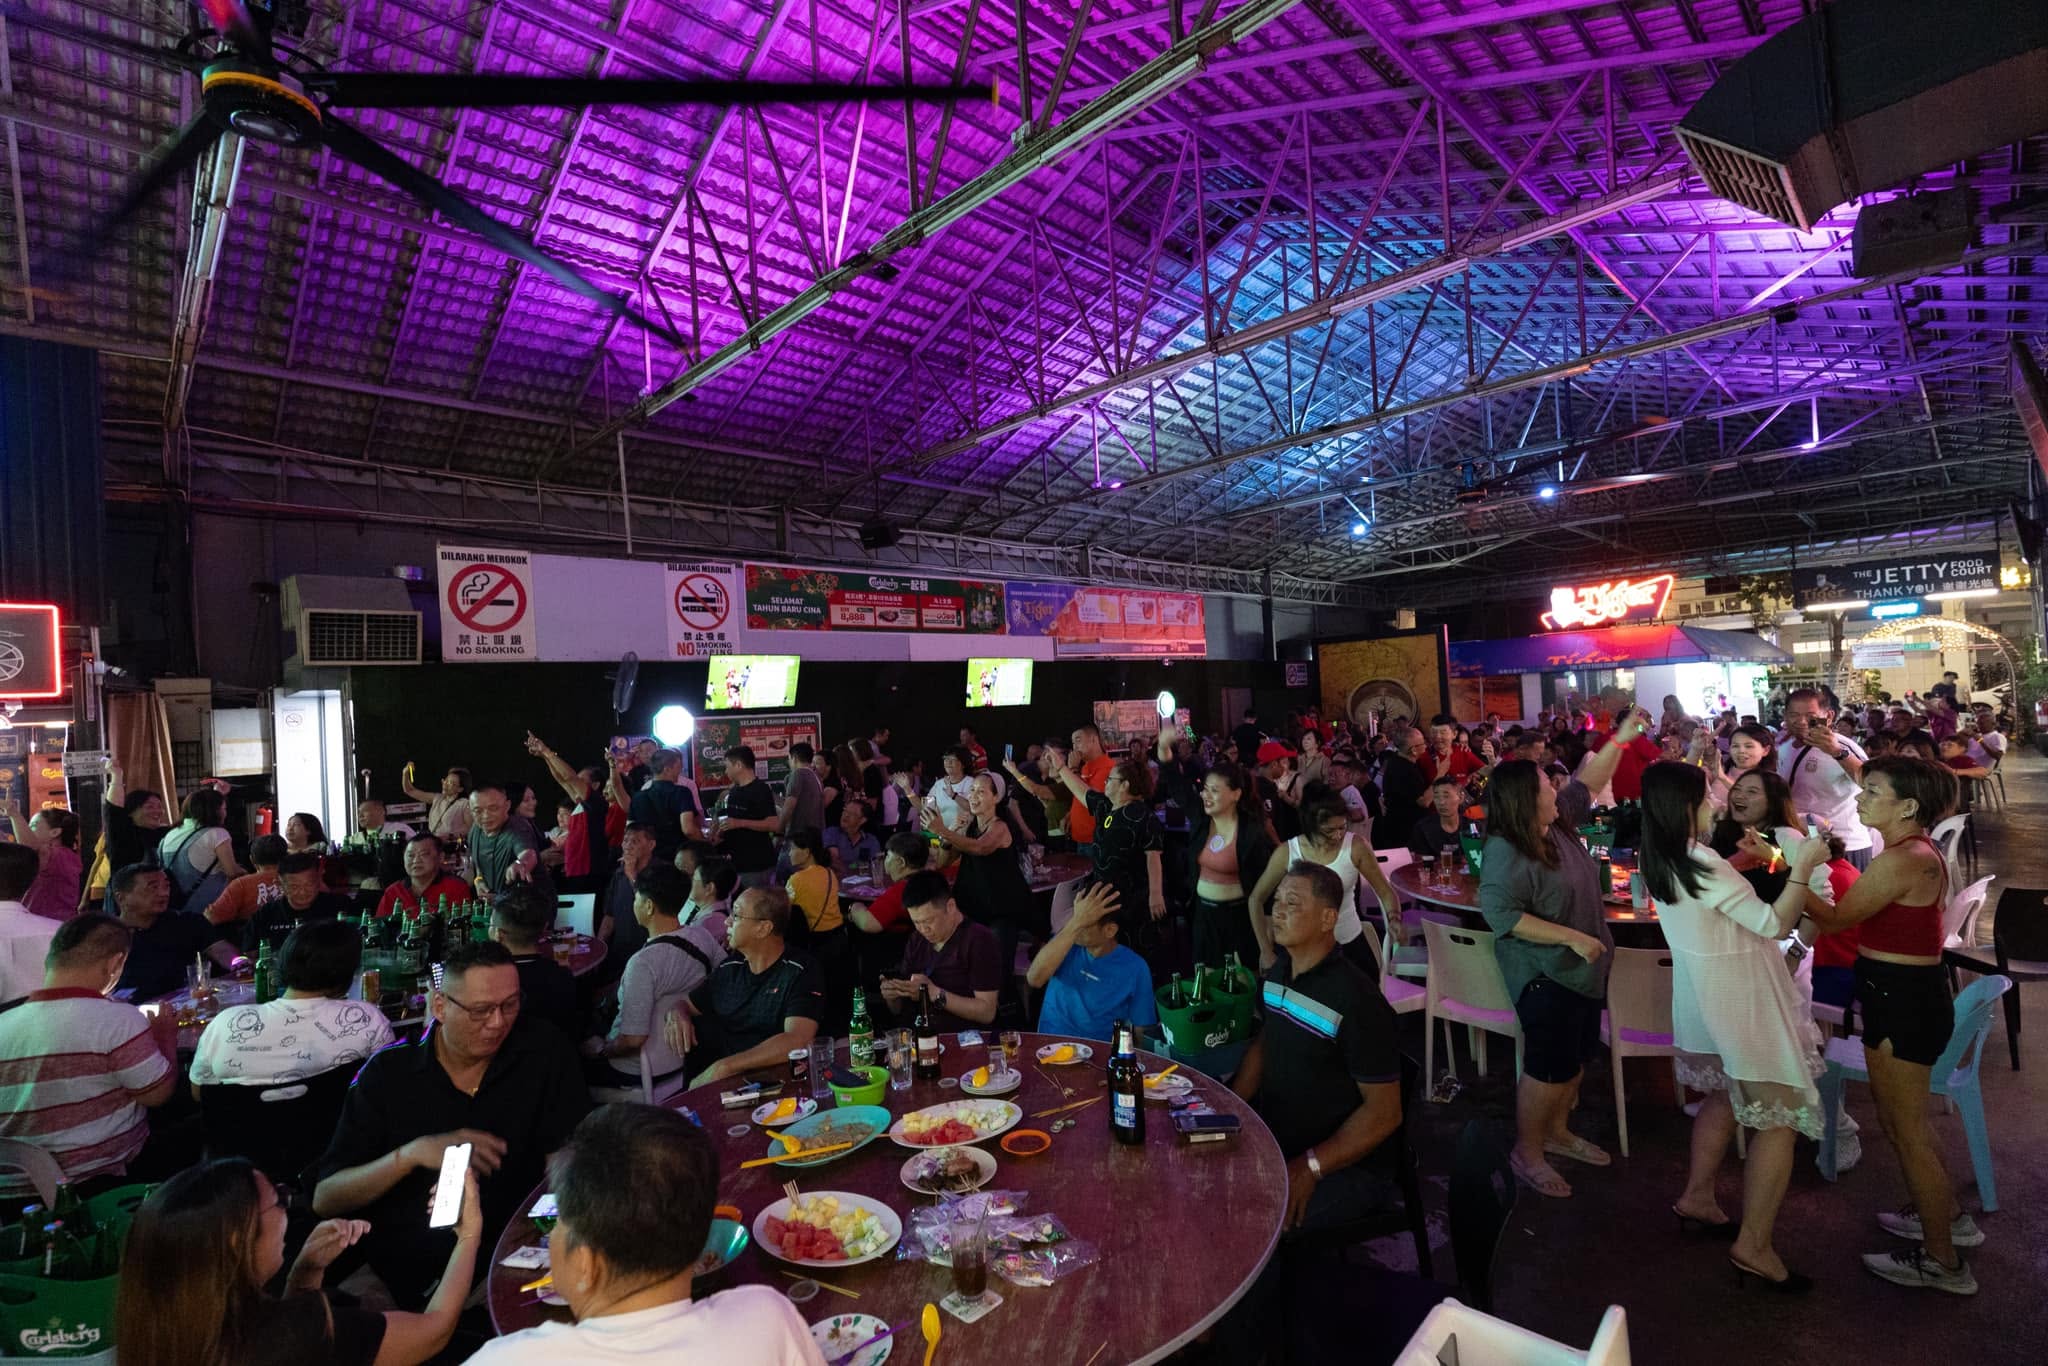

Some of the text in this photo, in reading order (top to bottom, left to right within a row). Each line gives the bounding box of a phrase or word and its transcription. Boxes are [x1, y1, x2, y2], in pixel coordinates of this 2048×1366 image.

[441, 551, 528, 565] DILARANG MEROKOK
[1950, 558, 1984, 569] FOOD
[1852, 561, 1949, 585] THE JETTY
[1950, 565, 1993, 577] COURT
[1801, 584, 1847, 601] Tiger
[1853, 583, 1904, 600] THANK
[770, 596, 804, 605] SELAMAT
[753, 603, 822, 614] TAHUN BARU CINA
[456, 646, 525, 655] NO SMOKING
[676, 641, 733, 657] NO SMOKING
[696, 648, 733, 656] VAPING
[19, 1323, 101, 1352] Carlsberg
